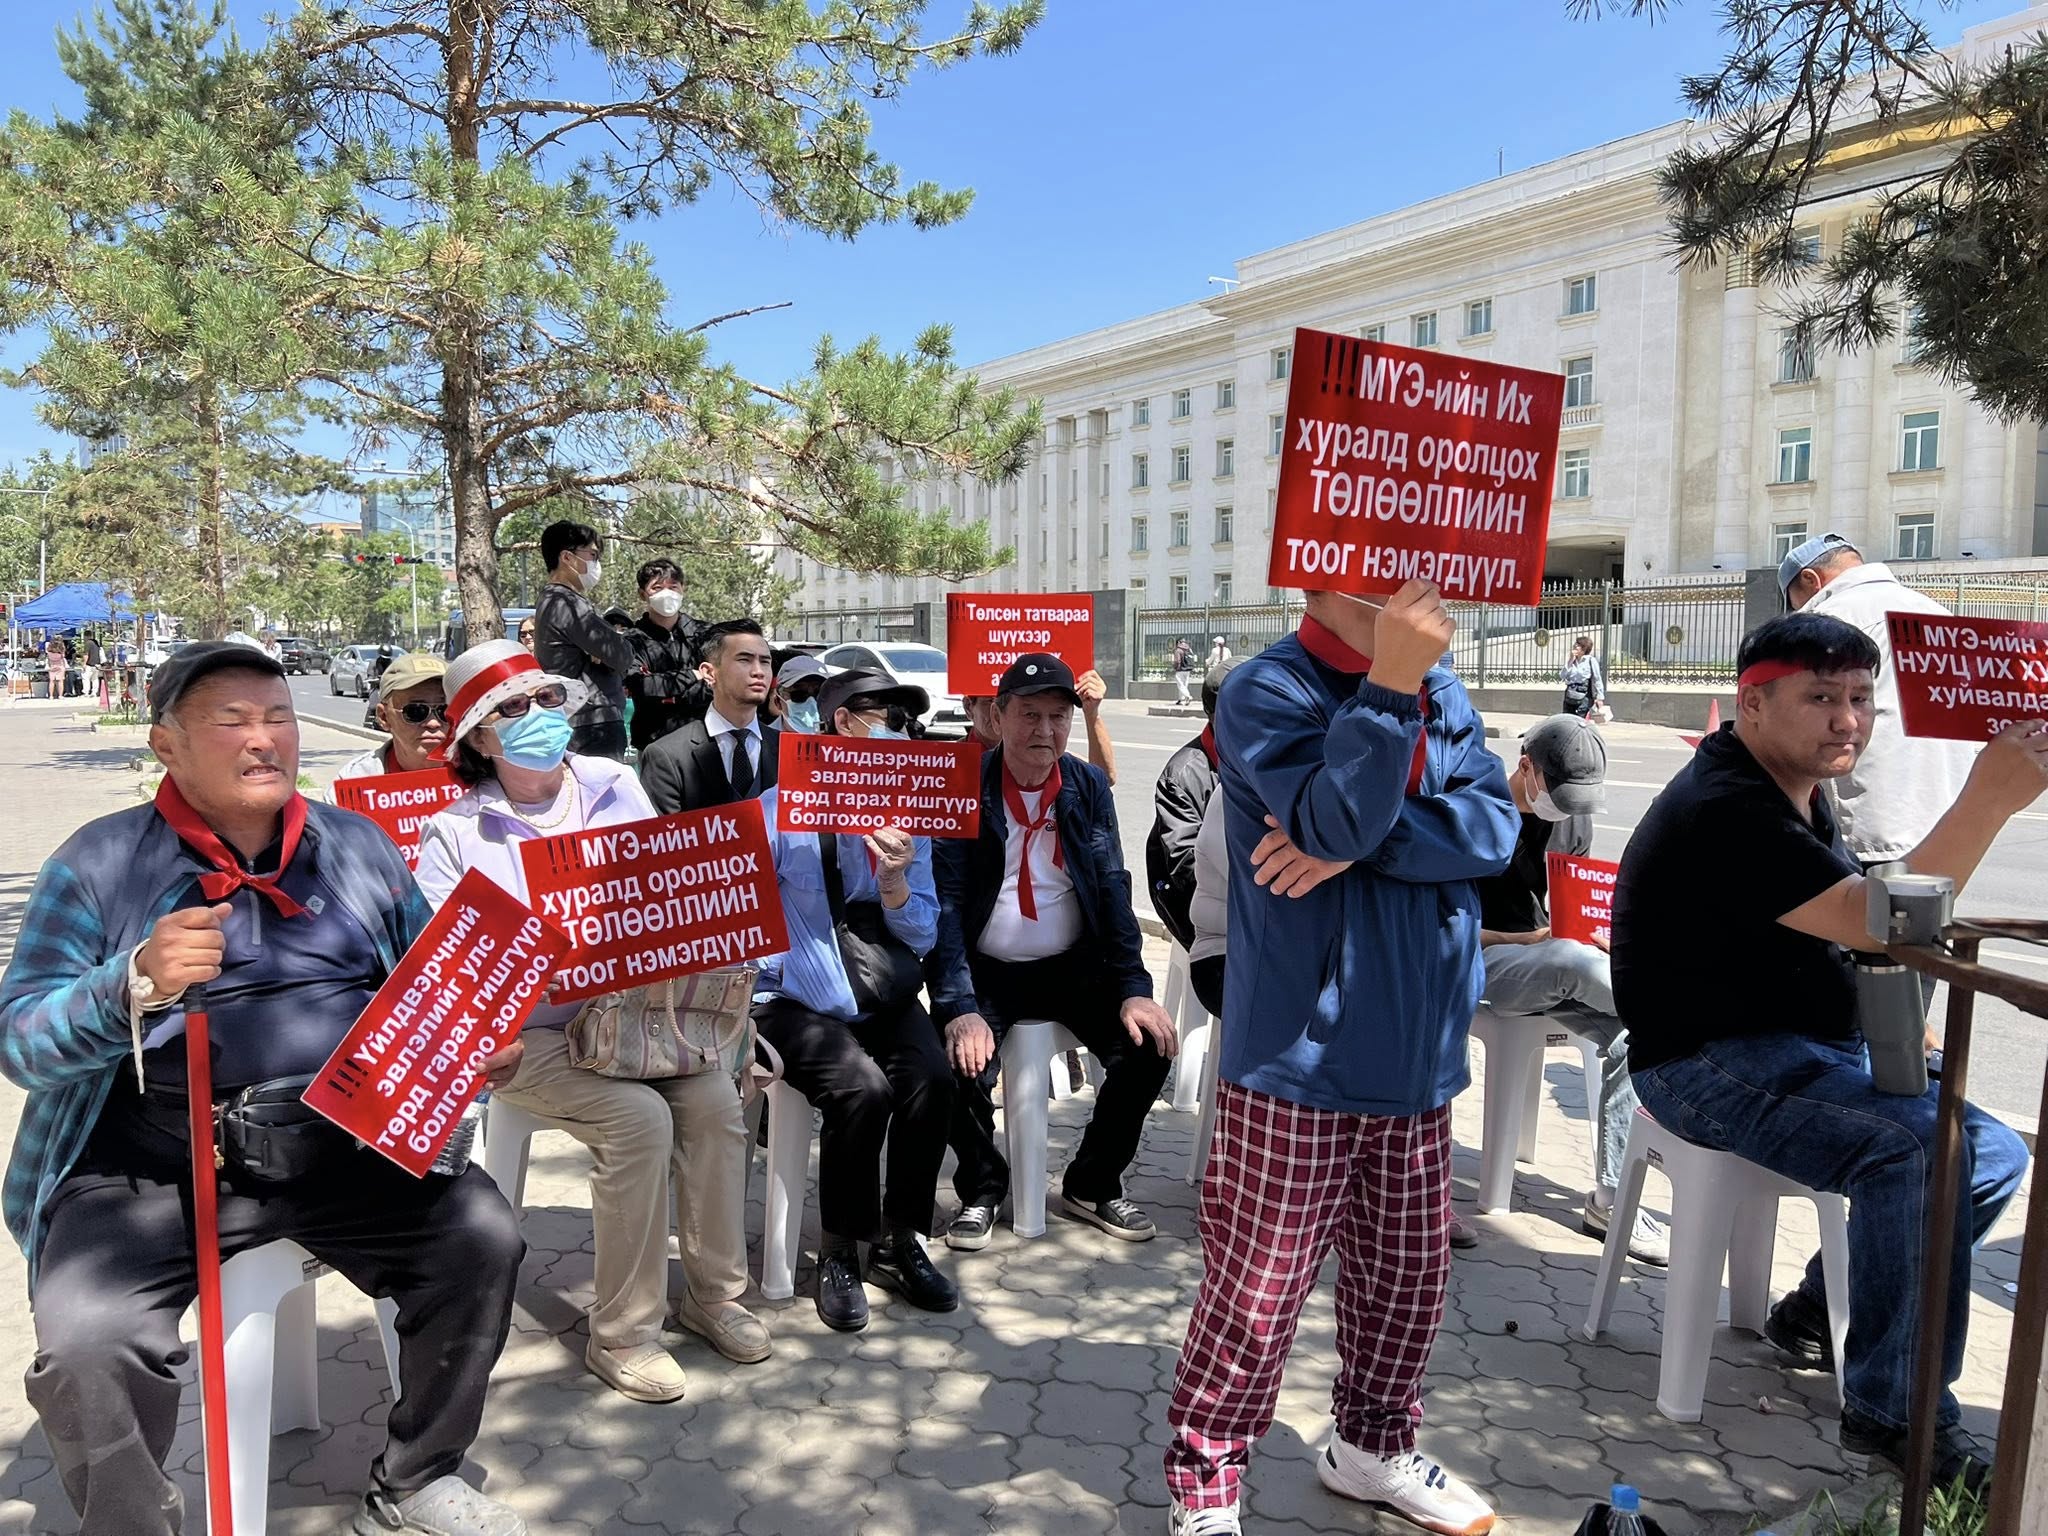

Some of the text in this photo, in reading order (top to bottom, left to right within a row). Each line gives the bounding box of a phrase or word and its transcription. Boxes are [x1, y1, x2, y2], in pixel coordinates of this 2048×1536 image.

[1496, 379, 1533, 425] Их
[1295, 418, 1540, 482] хуралд оролцох
[1310, 469, 1527, 535] ТӨЛӨӨЛЛИЙН
[1286, 538, 1522, 597] тоог нэмэгдүүл.
[988, 630, 1051, 647] шүүхээр
[1024, 608, 1090, 626] татвараа
[1897, 650, 1971, 681] НУУЦ
[1977, 656, 2014, 680] ИХ
[780, 789, 978, 814] төрд гарах гишгүүр
[810, 769, 946, 791] эвлэлийг улс
[703, 814, 740, 845] Их
[789, 808, 962, 831] болгохоо зогсоо.
[540, 852, 759, 921] хуралд оролцох
[1551, 857, 1617, 884] !!!Төлсө
[561, 882, 759, 949] ТӨЛӨӨЛЛИЙН
[556, 926, 772, 991] тоог нэмэгдүүл.
[376, 916, 543, 1148] төрд гарах гишгүүр
[377, 934, 496, 1098] эвлэлийг улс
[407, 952, 555, 1154] болгохоо зогсоо.
